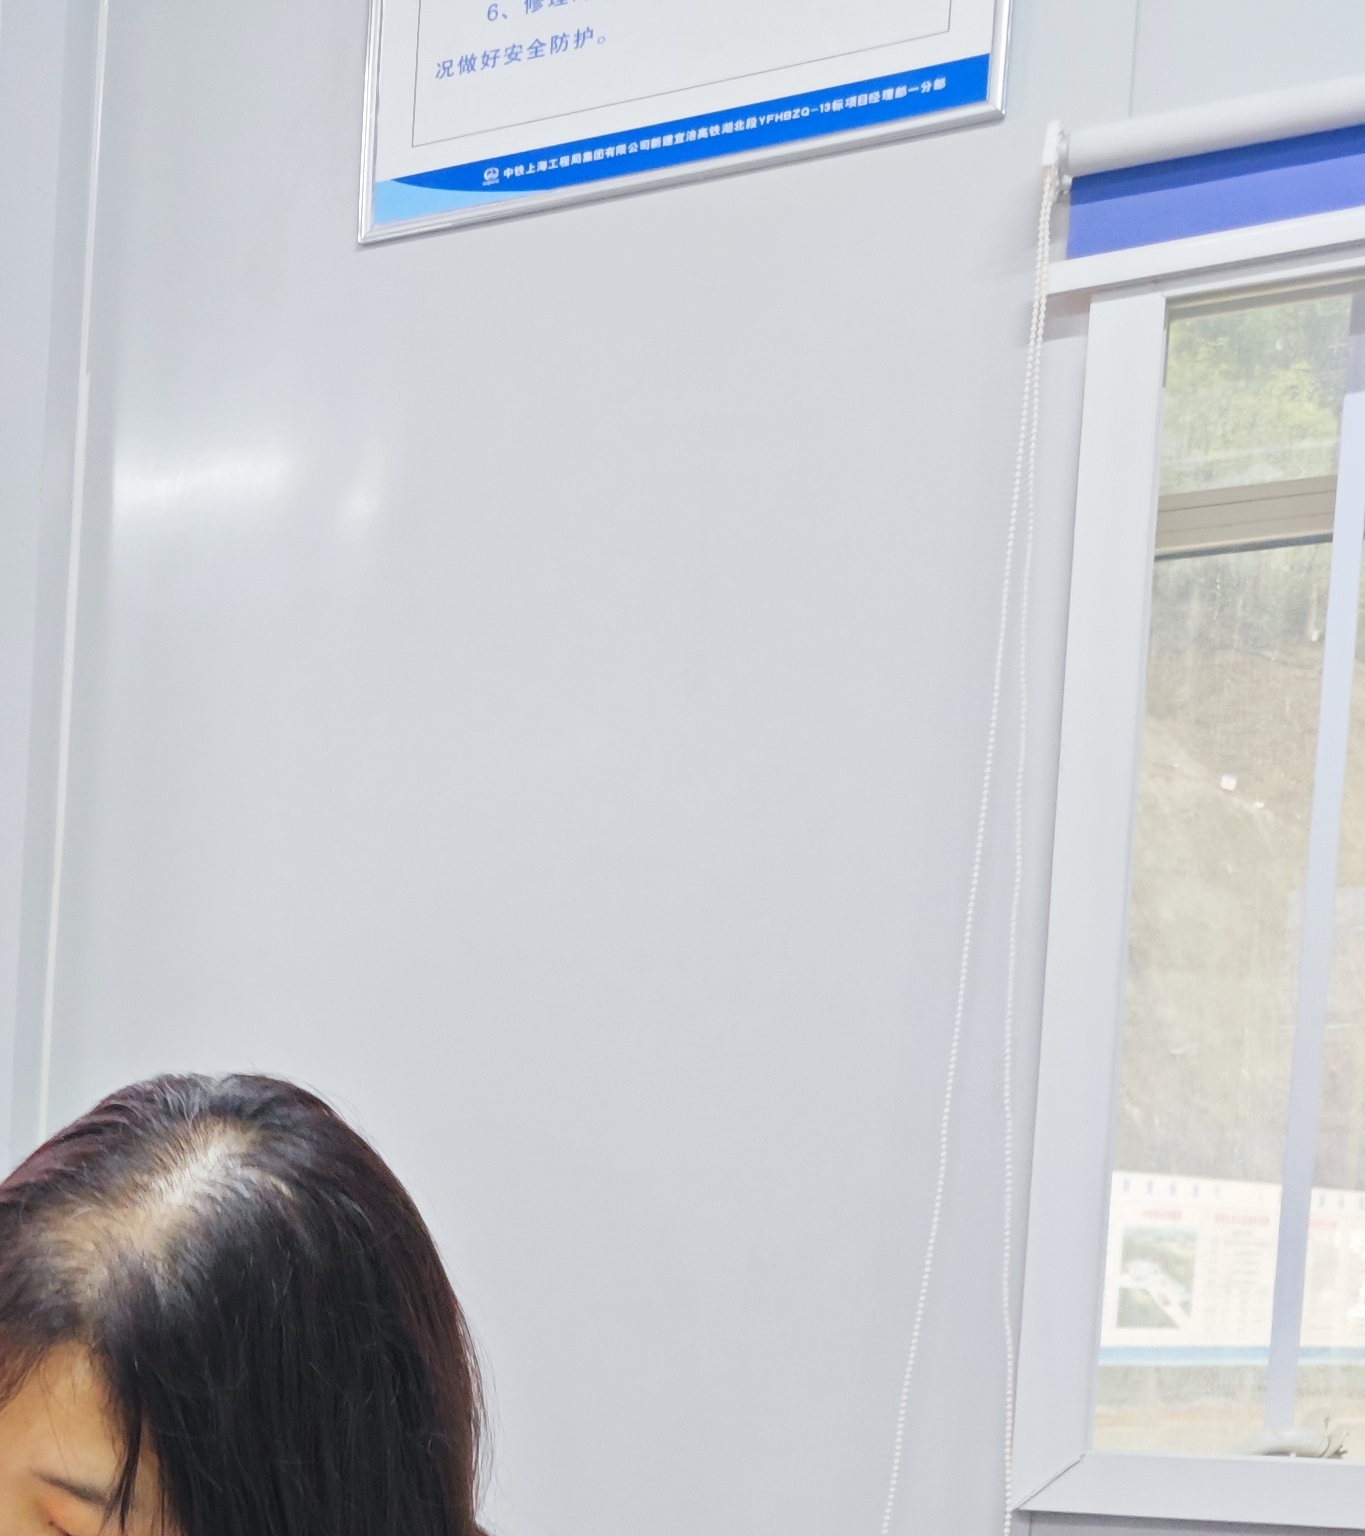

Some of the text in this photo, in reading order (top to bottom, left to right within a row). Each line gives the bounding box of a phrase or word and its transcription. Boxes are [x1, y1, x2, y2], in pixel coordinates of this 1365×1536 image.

[435, 26, 606, 80] 况做好安全防护。
